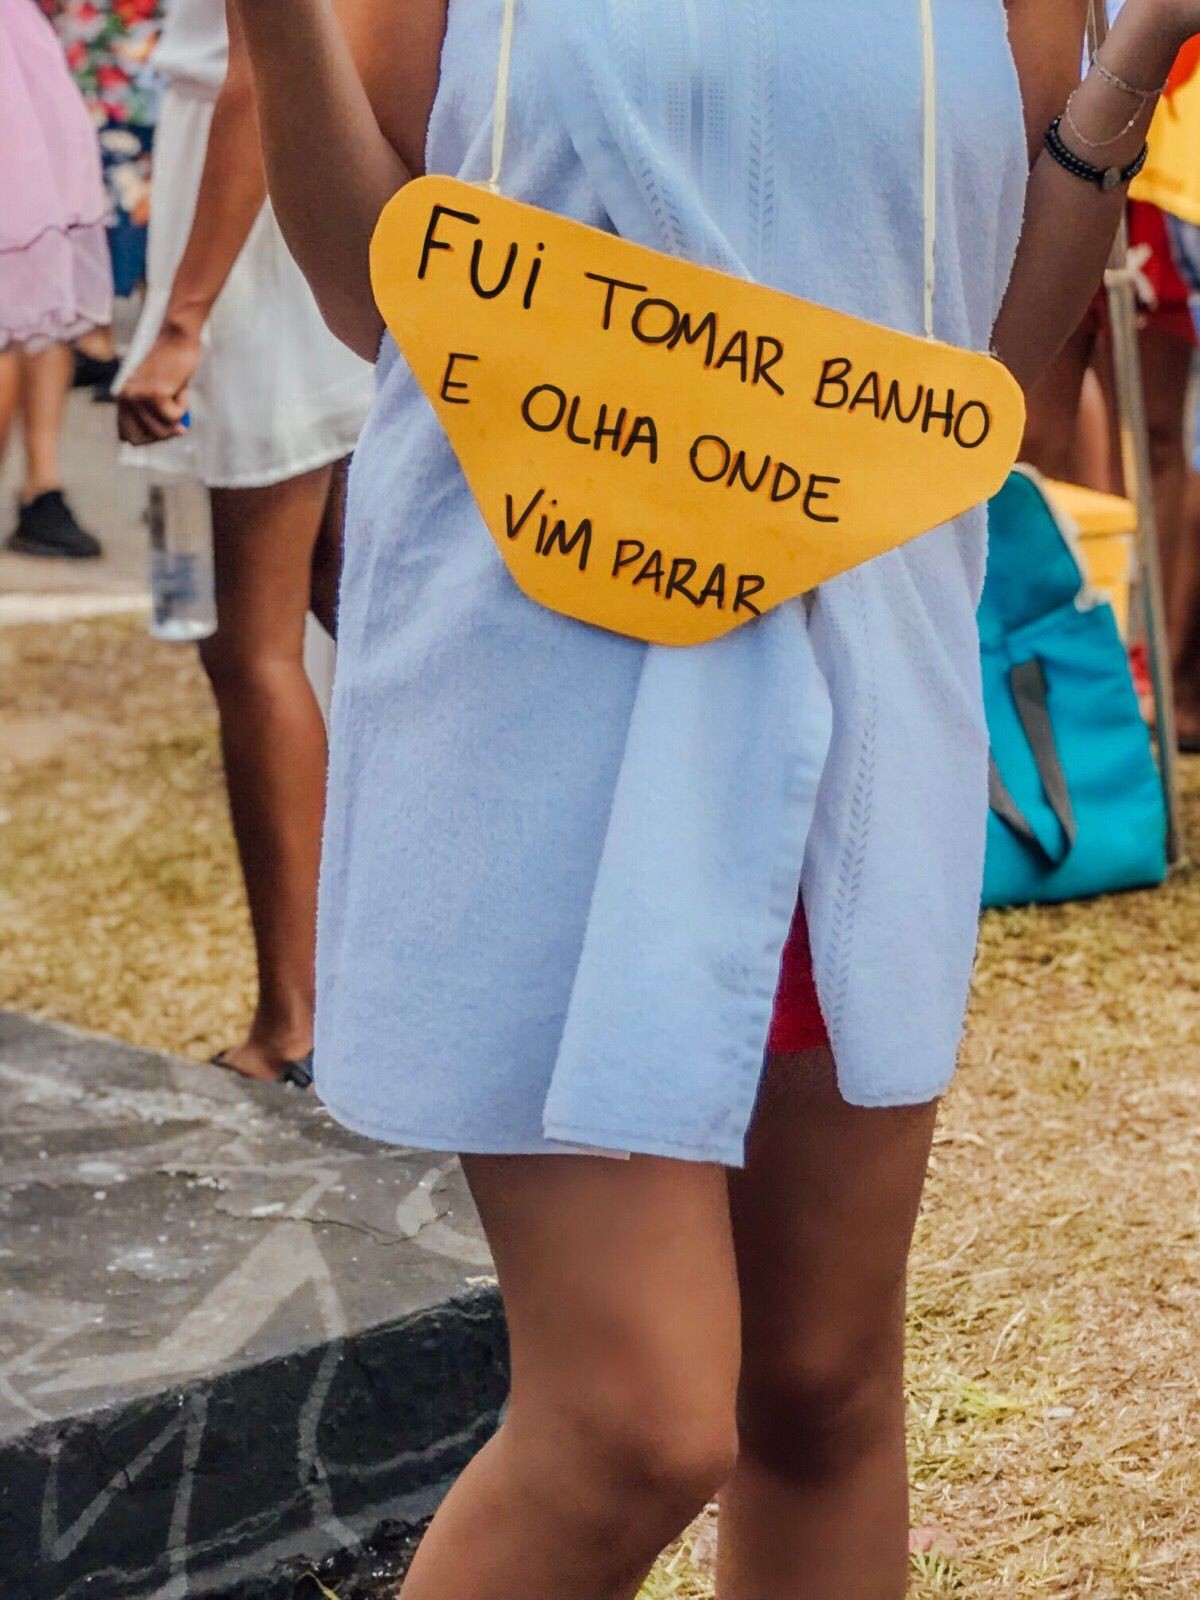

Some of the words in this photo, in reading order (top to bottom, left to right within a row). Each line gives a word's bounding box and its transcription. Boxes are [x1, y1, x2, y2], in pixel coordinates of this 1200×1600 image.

[439, 351, 480, 406] E
[520, 382, 659, 466] OLHA
[688, 433, 842, 524] ONDE
[584, 271, 786, 397] TOMAR
[813, 356, 991, 450] BANHO
[610, 538, 767, 617] PARAR
